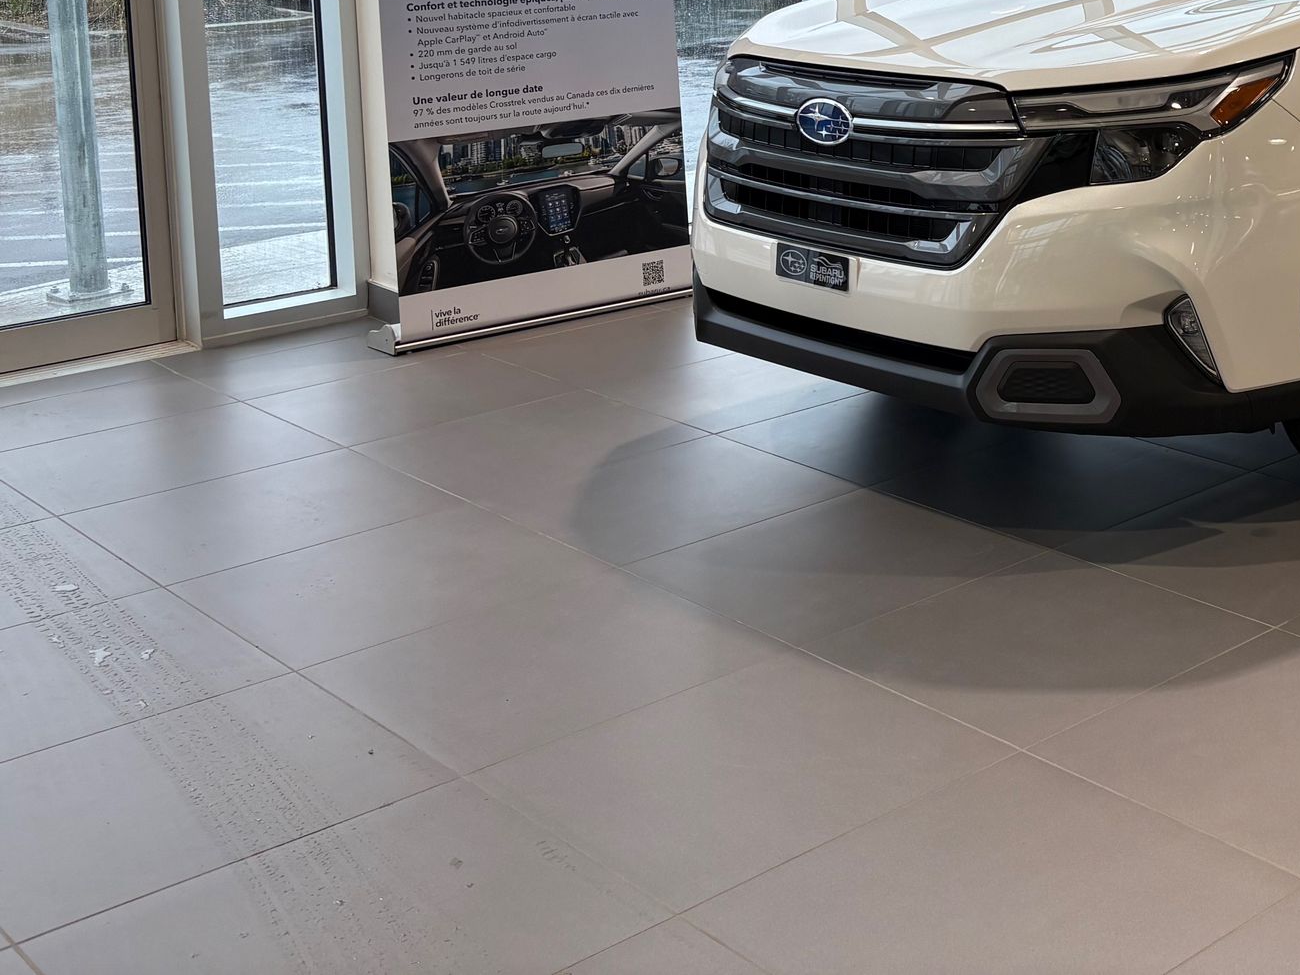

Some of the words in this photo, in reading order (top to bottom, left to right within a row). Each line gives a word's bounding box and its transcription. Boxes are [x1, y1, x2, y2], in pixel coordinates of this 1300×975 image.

[406, 1, 445, 12] Confort
[448, 0, 458, 8] et
[416, 14, 446, 23] Nouvel
[448, 11, 485, 21] habitacle
[488, 10, 522, 19] spacieux
[534, 4, 576, 14] confortable
[456, 25, 490, 33] système
[492, 16, 569, 29] d'infodivertissement
[599, 11, 620, 20] tactile
[417, 37, 442, 47] Apple
[492, 30, 524, 40] Android
[455, 46, 466, 55] de
[468, 44, 492, 56] garde
[506, 42, 518, 50] sol
[418, 60, 450, 70] Jusqu'à
[460, 56, 476, 66] 549
[478, 56, 498, 64] litres
[500, 54, 534, 62] d'espace
[536, 51, 557, 59] cargo
[420, 72, 464, 81] Longerons
[494, 66, 504, 74] de
[506, 64, 526, 73] série
[412, 96, 434, 105] Une
[436, 92, 468, 103] valeur
[470, 90, 482, 99] de
[485, 88, 520, 98] longue
[522, 84, 543, 94] date
[413, 108, 424, 117] 97
[436, 106, 450, 114] des
[452, 102, 488, 112] modèles
[490, 98, 526, 109] Crosstrek
[528, 95, 554, 104] vendus
[566, 90, 595, 100] Canada
[610, 87, 620, 95] dix
[622, 84, 654, 94] dernières
[414, 120, 444, 129] années
[446, 117, 463, 125] sont
[465, 114, 498, 123] toujours
[522, 108, 541, 116] route
[810, 264, 844, 278] SUBARU
[435, 310, 452, 318] vive
[454, 306, 461, 314] la
